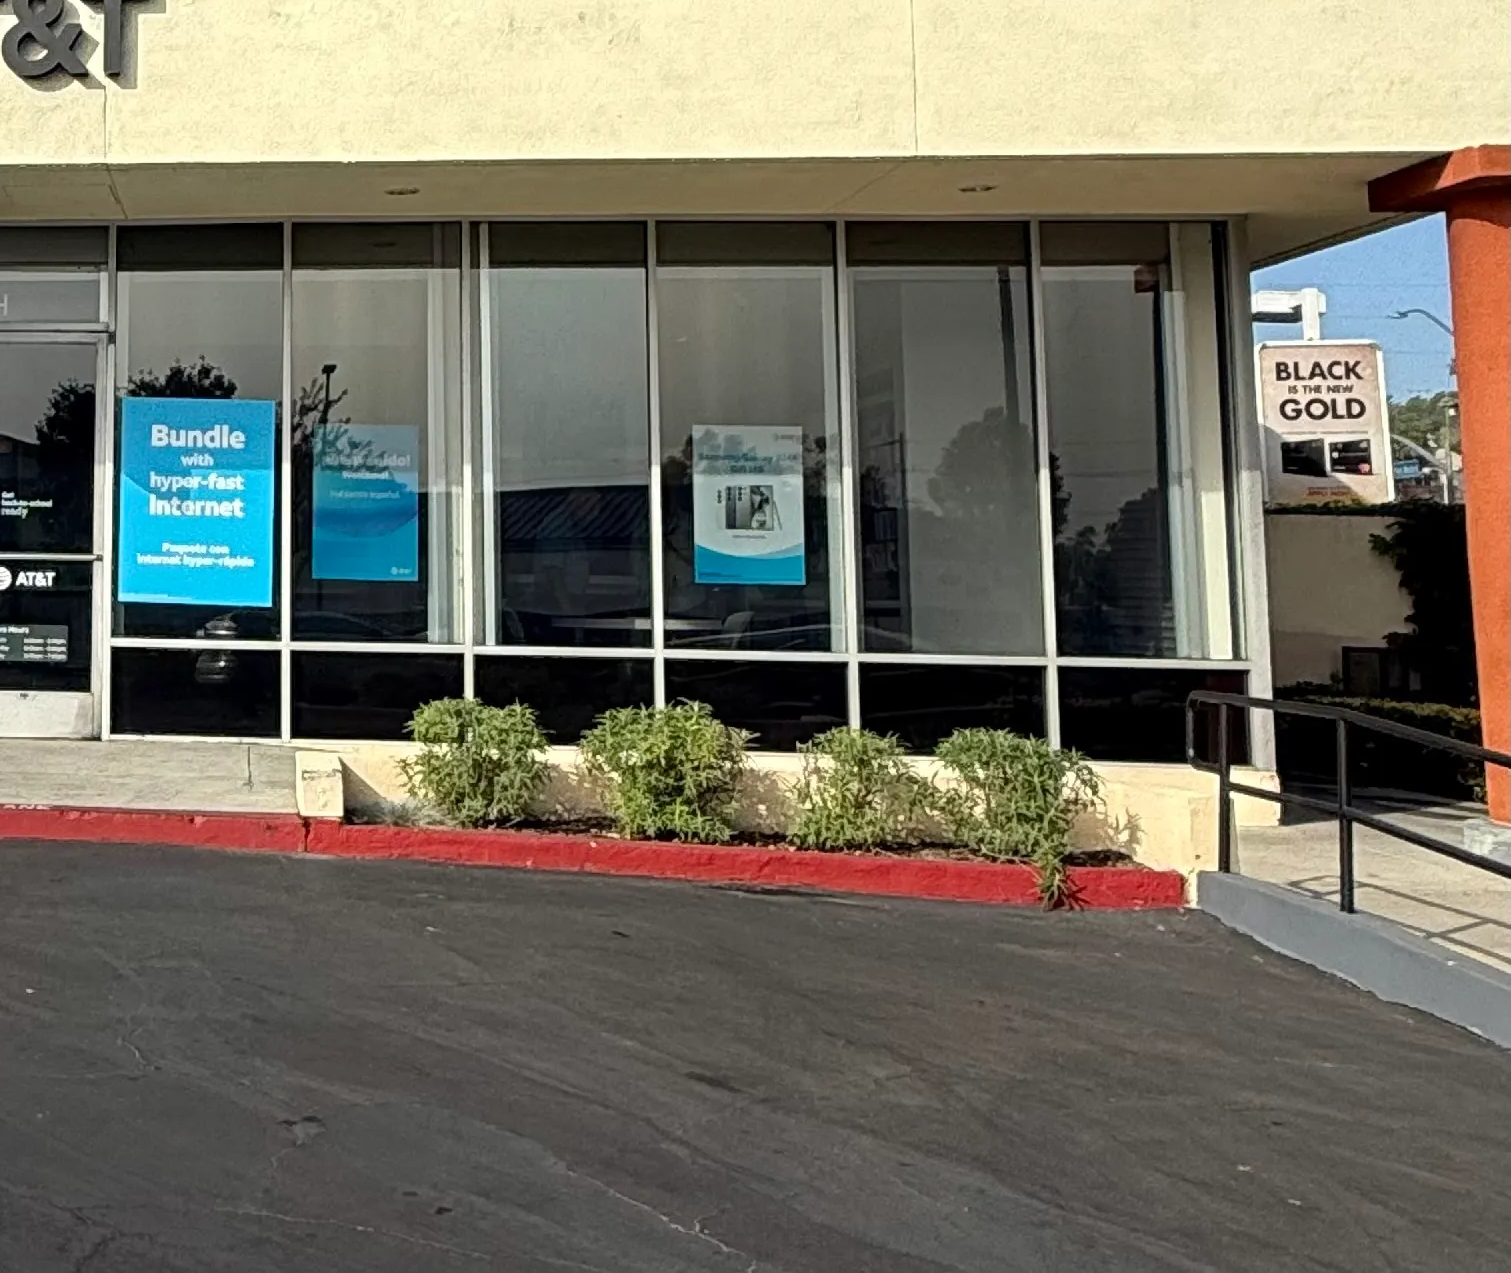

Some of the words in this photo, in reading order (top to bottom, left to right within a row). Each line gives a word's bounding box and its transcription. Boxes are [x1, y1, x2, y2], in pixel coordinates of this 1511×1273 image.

[1275, 360, 1364, 381] BLACK
[1288, 384, 1299, 395] IS
[1302, 384, 1323, 395] THE
[1327, 384, 1354, 395] NEW
[1279, 398, 1366, 421] GOLD
[151, 424, 246, 449] Bundle
[180, 453, 214, 467] with
[149, 471, 246, 492] hyper-fast
[149, 494, 246, 519] Internet
[15, 571, 56, 587] AT&T
